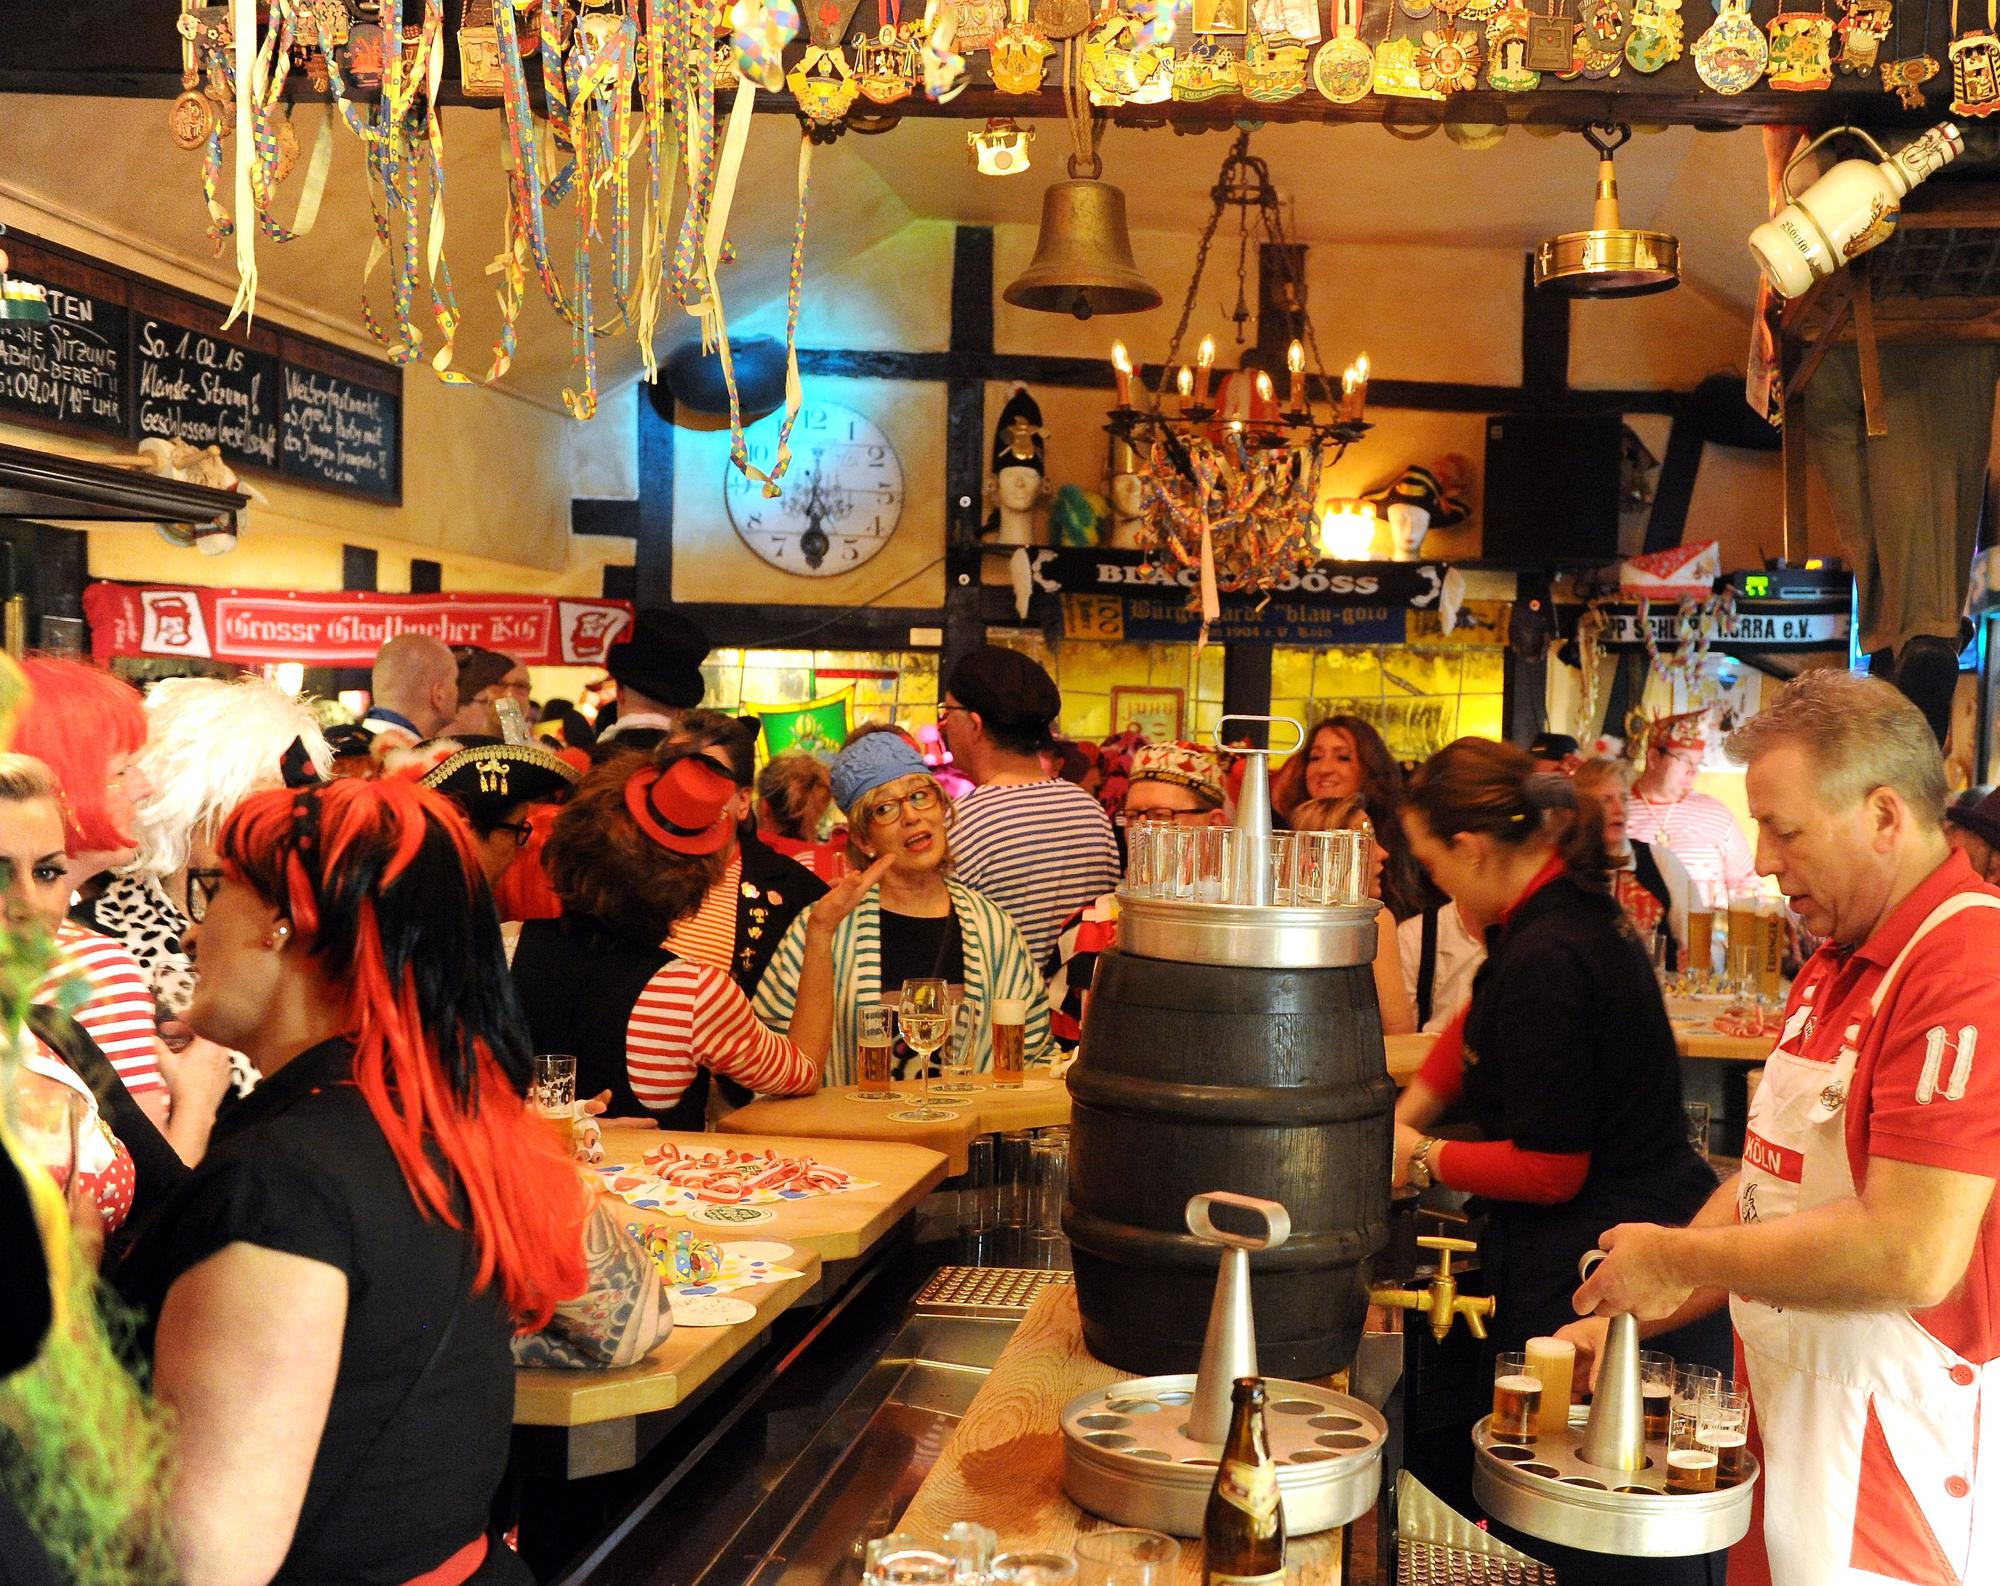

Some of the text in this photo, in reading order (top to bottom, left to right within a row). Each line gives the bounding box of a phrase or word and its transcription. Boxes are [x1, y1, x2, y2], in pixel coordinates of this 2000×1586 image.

[50, 325, 117, 371] SITZUNG
[138, 321, 245, 372] So. 1.02.15
[92, 399, 122, 424] UHR
[805, 409, 828, 431] 12
[1096, 563, 1205, 587] BLÄC
[1783, 618, 1813, 639] e.V.
[1915, 1024, 1979, 1106] 11
[1746, 1135, 1782, 1175] KÖLN
